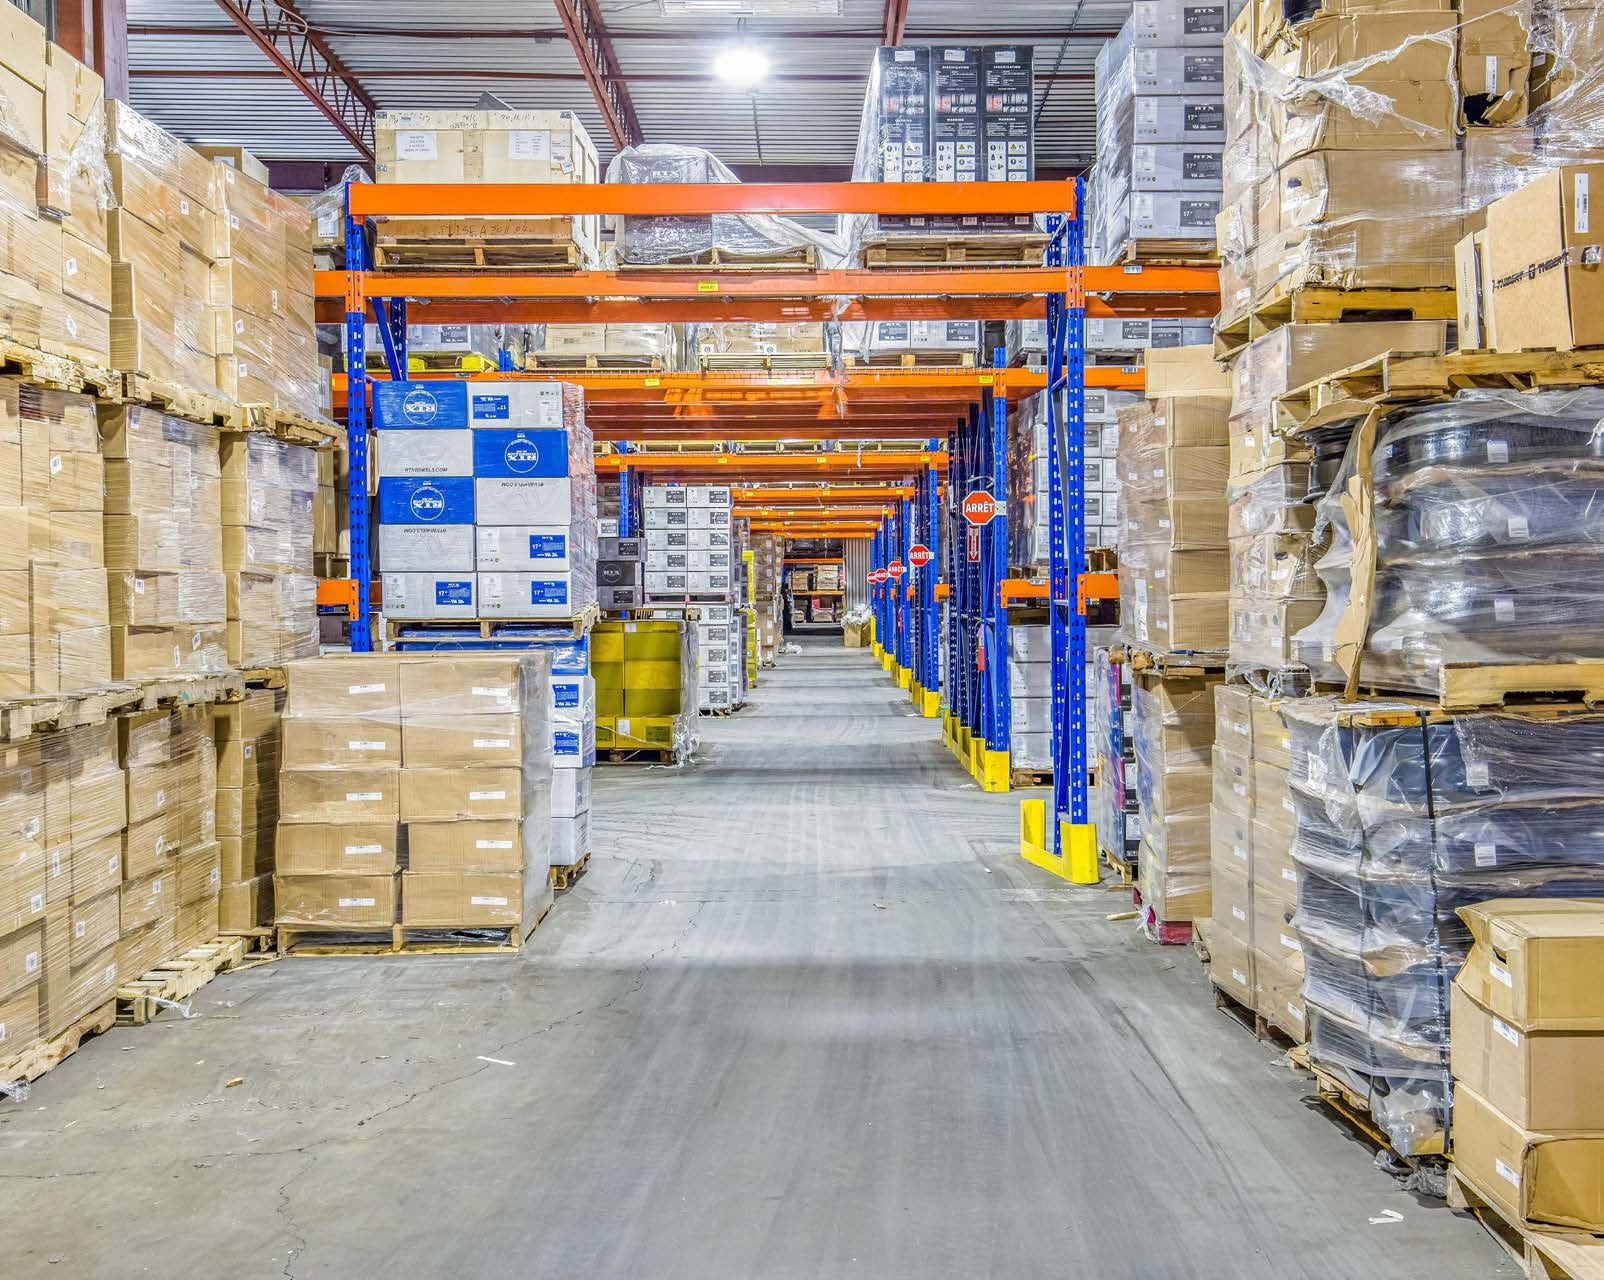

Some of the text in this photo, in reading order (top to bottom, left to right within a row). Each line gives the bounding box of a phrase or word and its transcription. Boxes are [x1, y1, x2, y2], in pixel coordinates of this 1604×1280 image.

[652, 170, 679, 178] RTX
[405, 403, 436, 412] RTX
[507, 453, 537, 461] RTX
[412, 500, 442, 509] RTX
[965, 501, 994, 513] ARRÊT
[910, 550, 929, 560] ARRÊT
